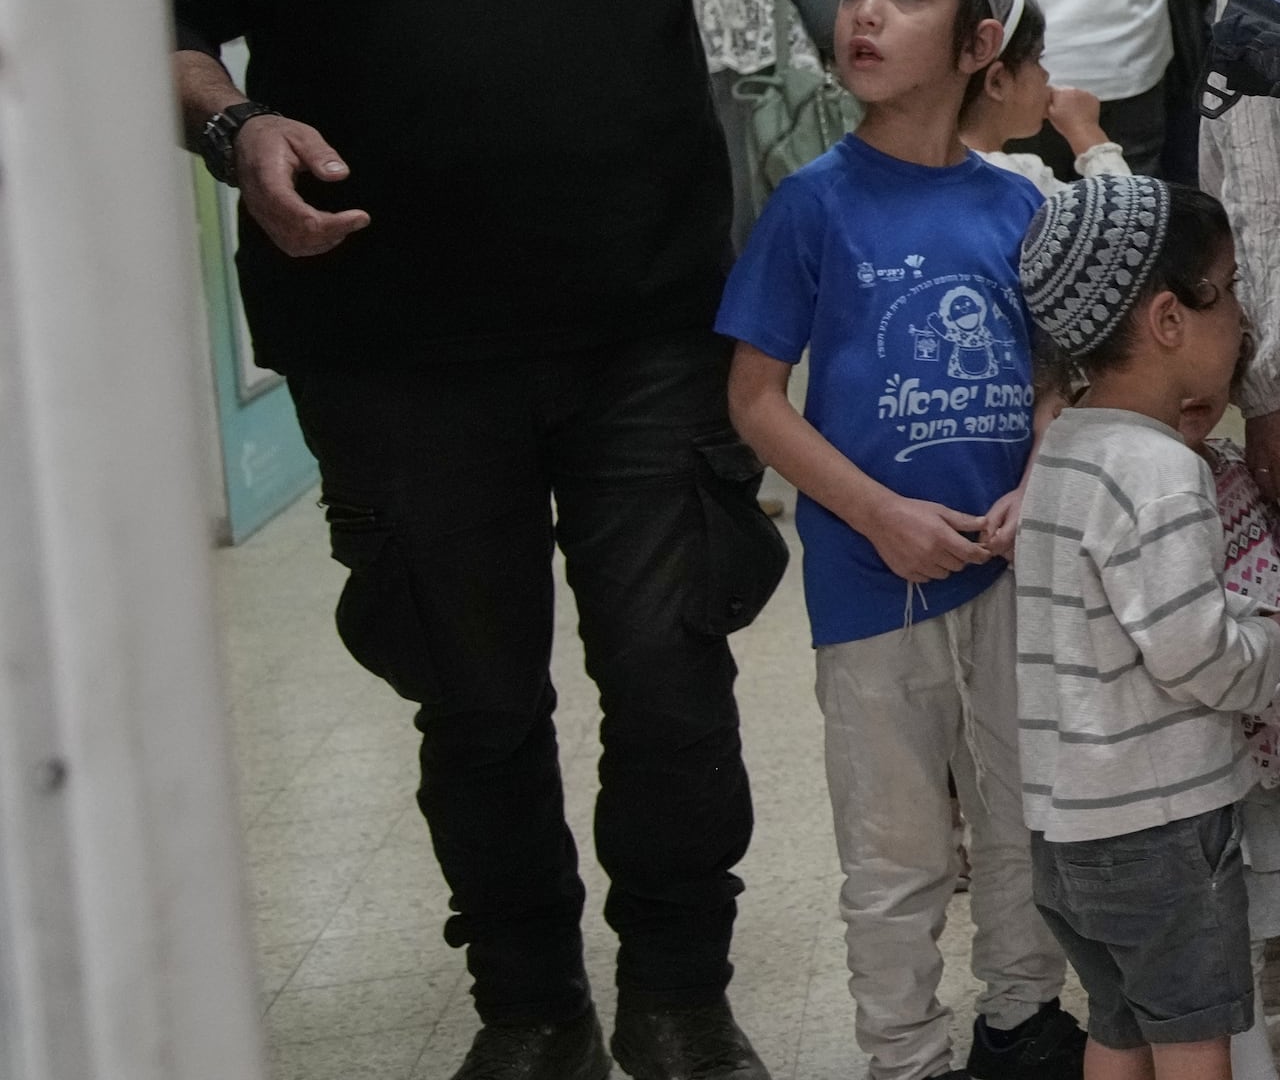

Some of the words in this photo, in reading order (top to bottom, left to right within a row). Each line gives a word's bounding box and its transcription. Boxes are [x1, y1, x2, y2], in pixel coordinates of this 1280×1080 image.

[878, 310, 892, 332] ארבע
[879, 378, 978, 419] ישראלה
[985, 383, 1034, 408] סבתא
[909, 419, 957, 441] היום
[964, 415, 995, 434] ועד
